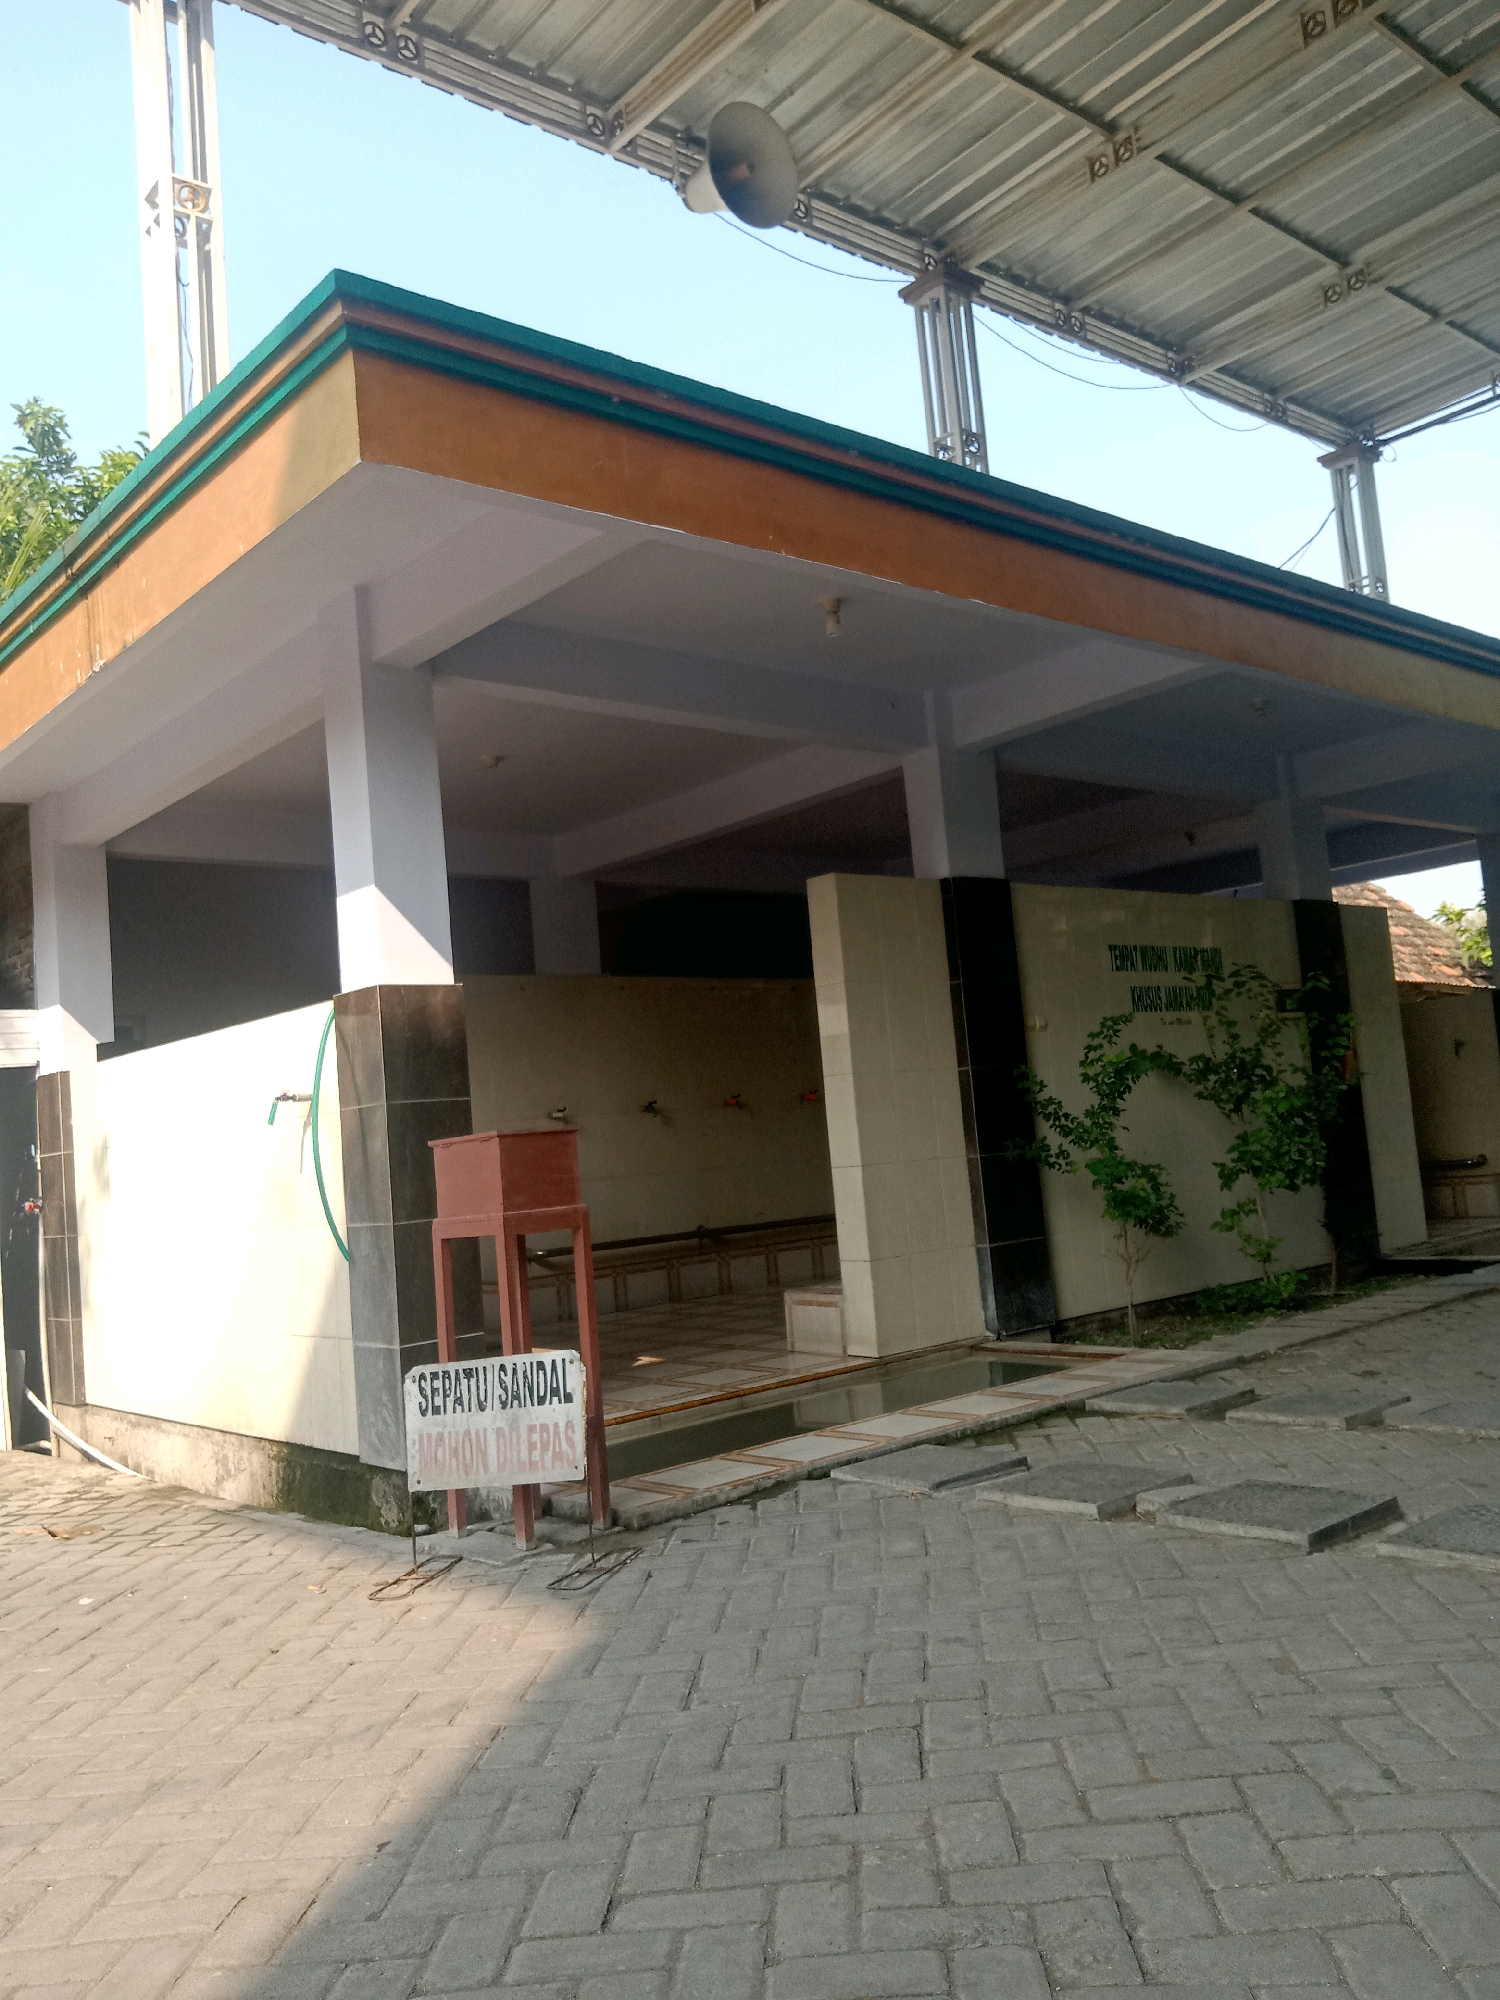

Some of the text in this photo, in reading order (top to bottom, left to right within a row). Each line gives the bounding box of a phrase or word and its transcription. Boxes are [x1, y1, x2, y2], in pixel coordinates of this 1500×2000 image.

[1108, 944, 1138, 972] TEMPAT
[1139, 945, 1169, 972] WUDHU
[1130, 985, 1163, 1012] KHUSUS
[418, 1420, 577, 1478] MOHON DILEPAS
